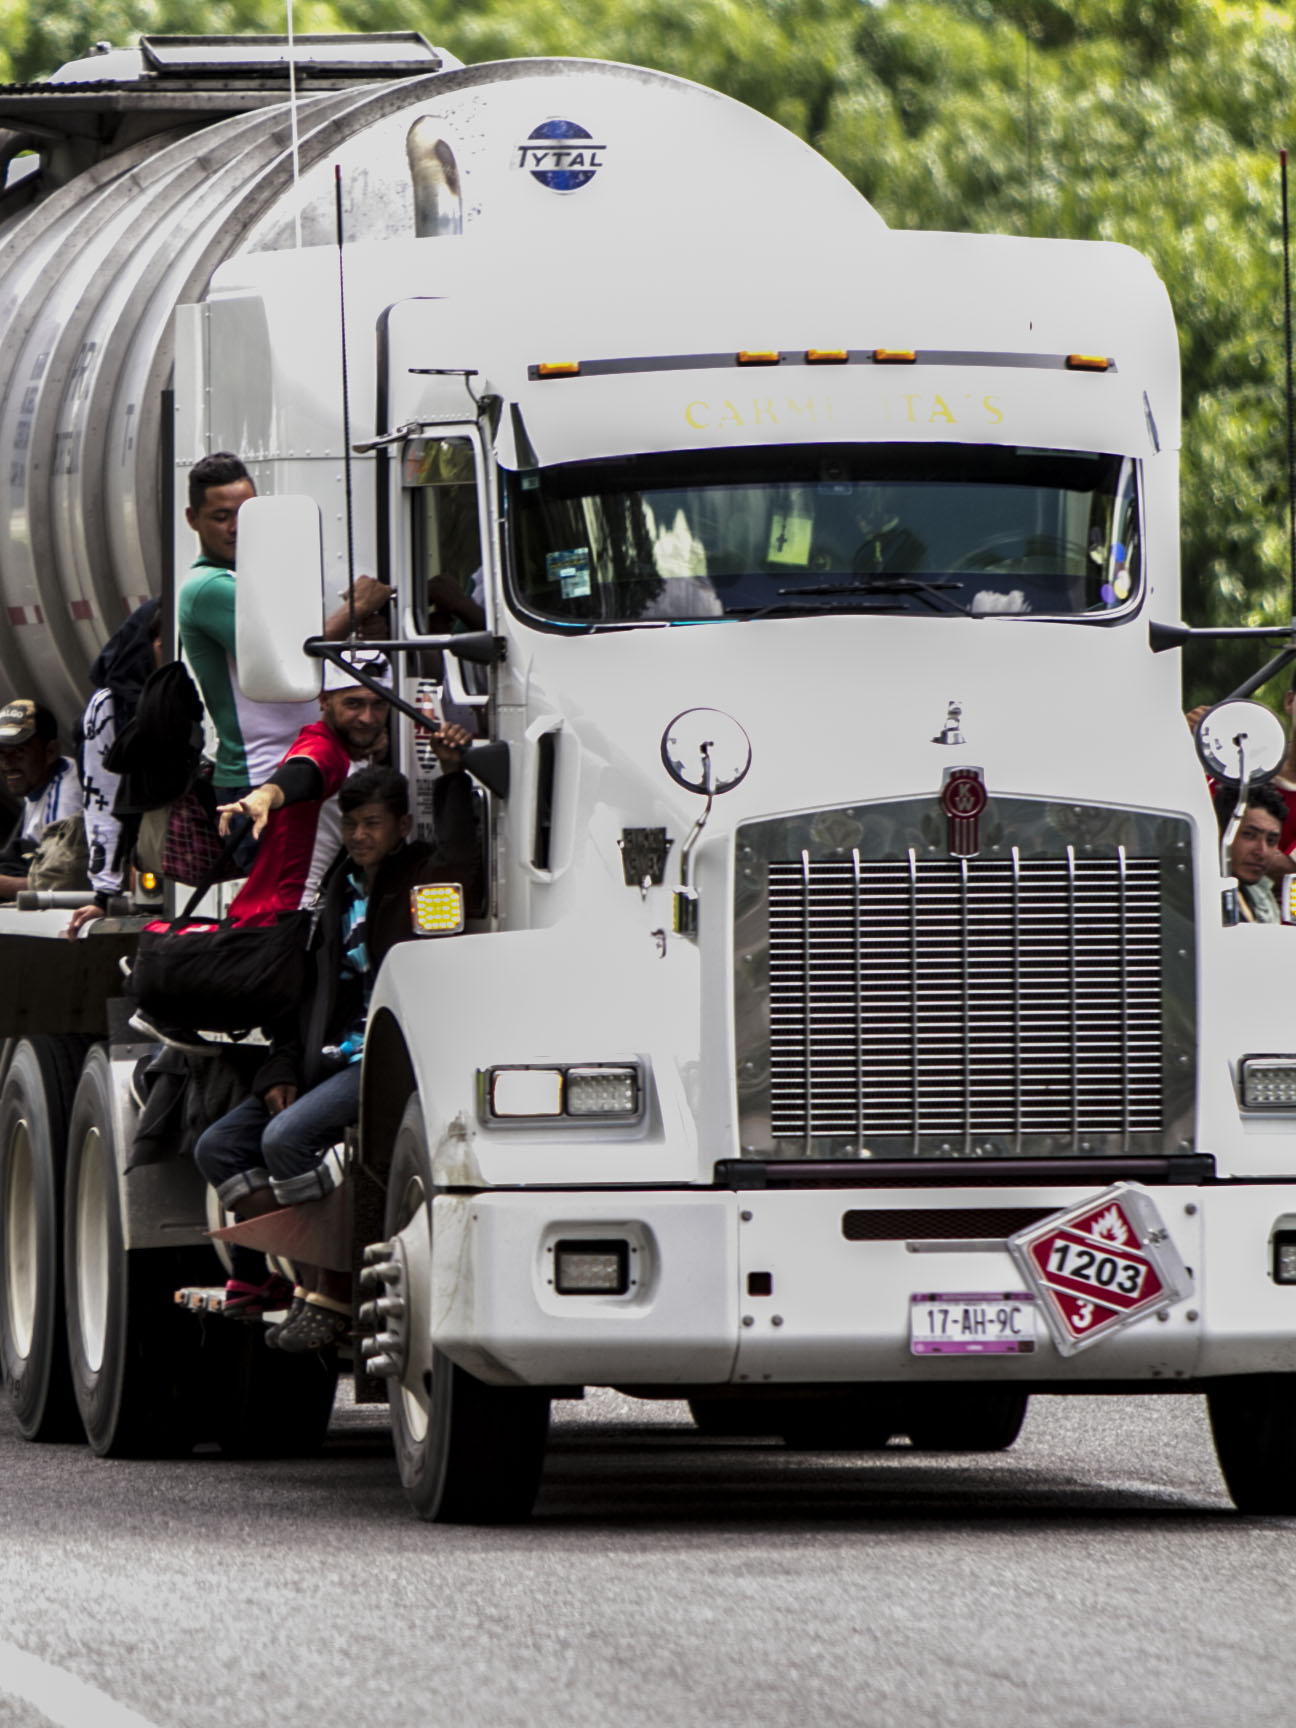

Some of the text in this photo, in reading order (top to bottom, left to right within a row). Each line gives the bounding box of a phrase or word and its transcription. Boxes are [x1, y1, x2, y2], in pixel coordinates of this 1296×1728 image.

[518, 145, 607, 168] TYTAL
[1054, 1244, 1141, 1294] 1203
[927, 1306, 1022, 1335] 17-AH-9C
[1071, 1299, 1095, 1328] 3
